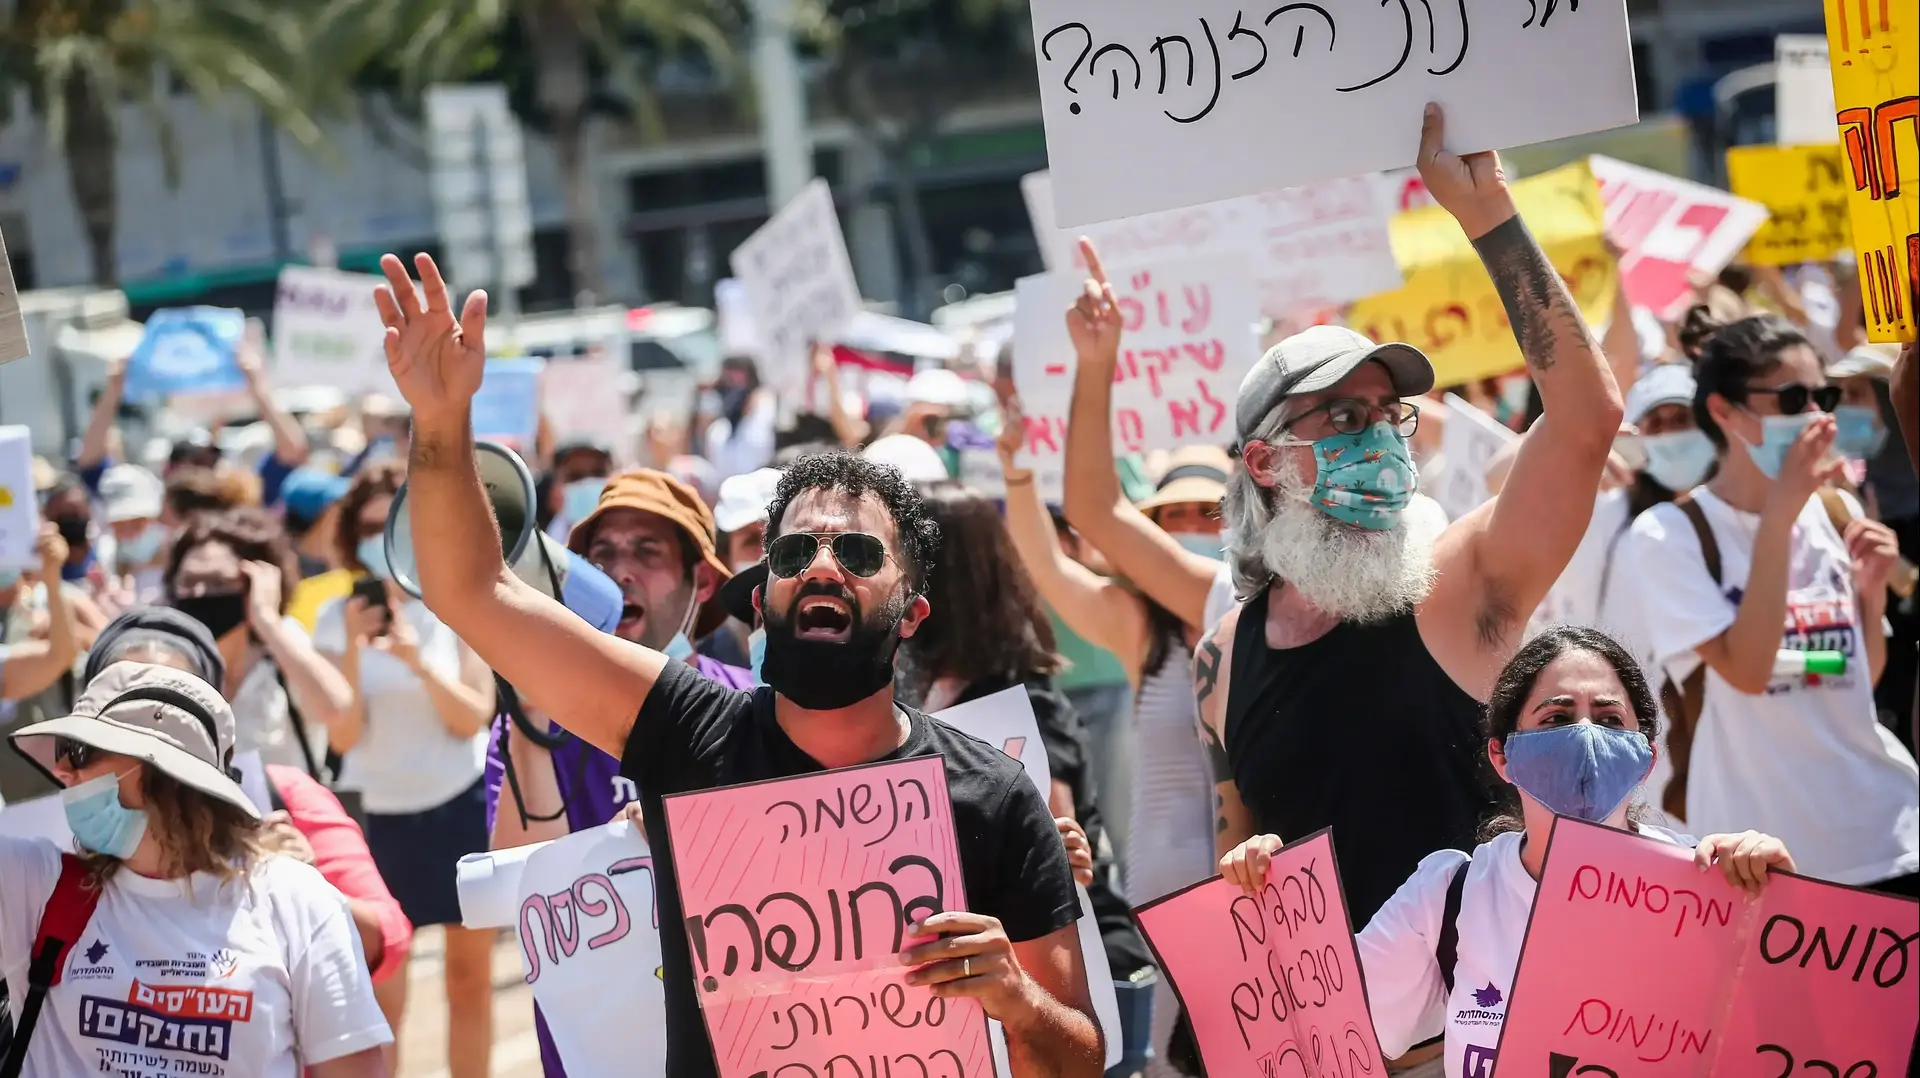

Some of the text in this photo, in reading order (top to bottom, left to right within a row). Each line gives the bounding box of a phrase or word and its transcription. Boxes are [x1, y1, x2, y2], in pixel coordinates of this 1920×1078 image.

[1041, 3, 1336, 123] הזנחה?
[1113, 339, 1225, 399] שיקו
[1167, 378, 1226, 439] לא
[764, 777, 931, 848] הנשמה
[1229, 857, 1326, 962] עבדים
[1567, 864, 1919, 988] עומס מקסימום
[82, 998, 225, 1055] נחנקים!
[136, 981, 248, 1019] העו"סים
[1231, 944, 1343, 1051] סוציאלים
[1562, 998, 1712, 1062] מינימום
